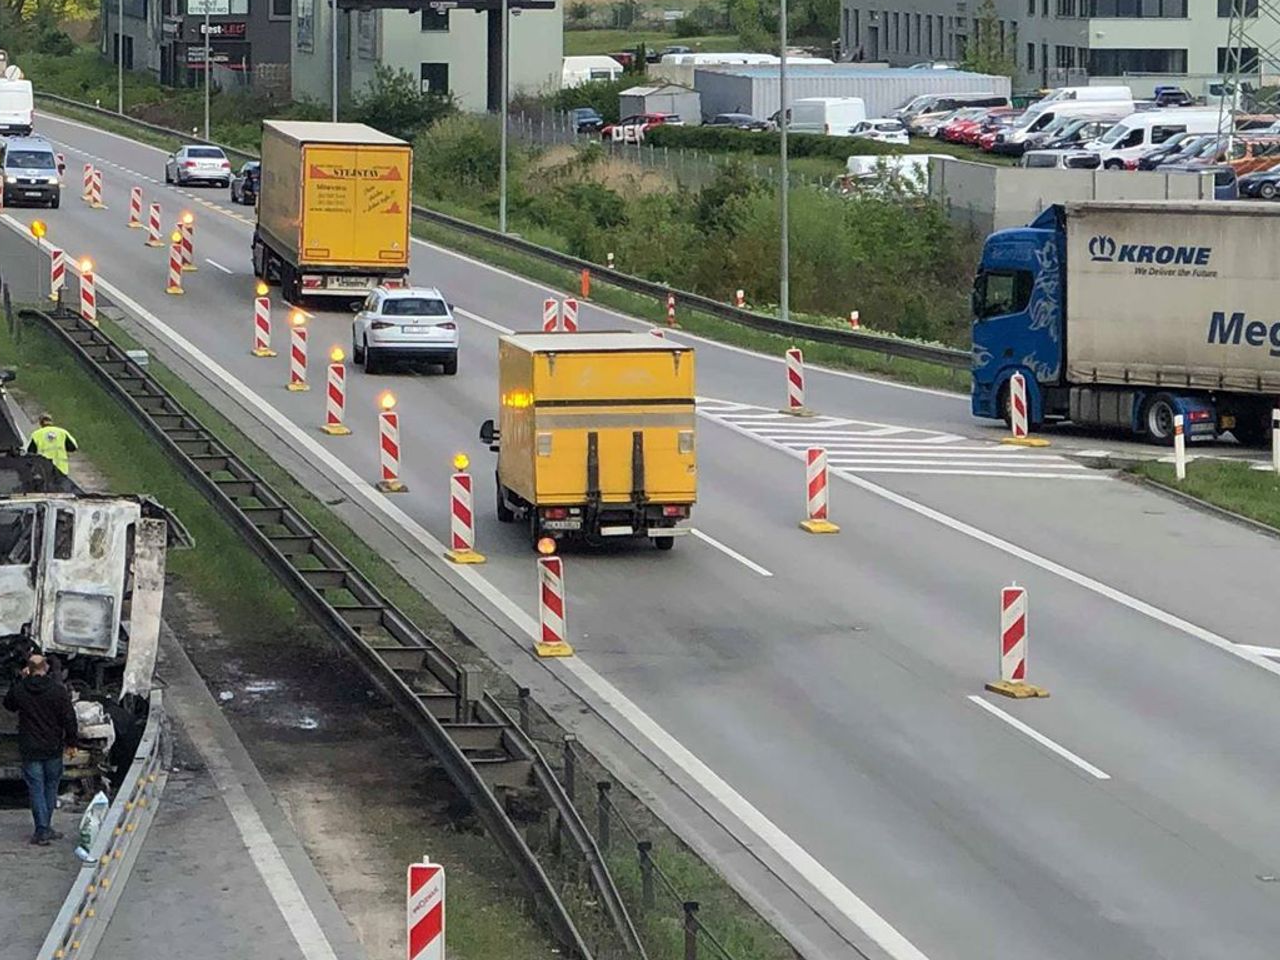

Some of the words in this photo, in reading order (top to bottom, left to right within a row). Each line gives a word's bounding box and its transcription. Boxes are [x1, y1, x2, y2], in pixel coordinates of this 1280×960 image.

[1118, 244, 1211, 265] KRONE
[1134, 267, 1147, 276] We
[1148, 267, 1176, 277] Deliver
[1177, 268, 1191, 277] the
[1192, 269, 1218, 278] Future
